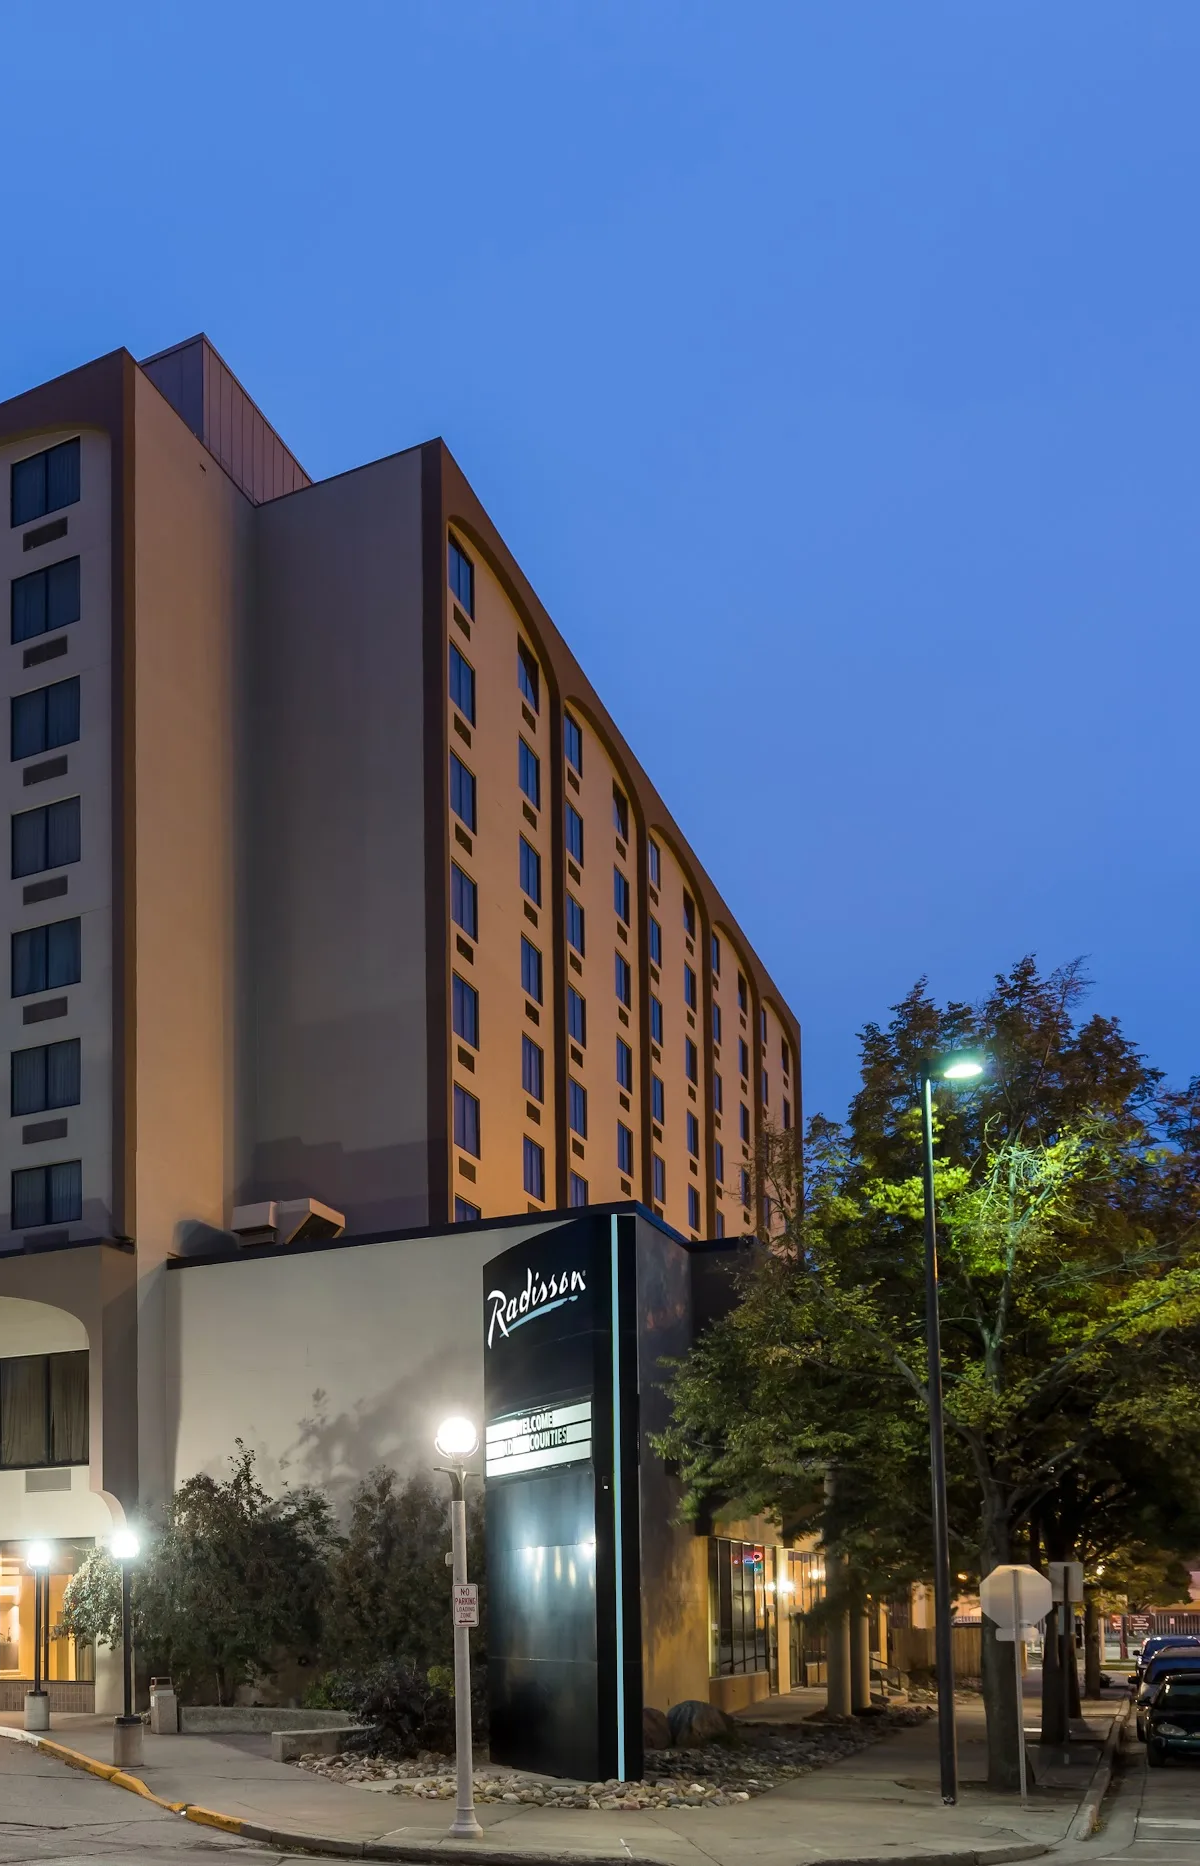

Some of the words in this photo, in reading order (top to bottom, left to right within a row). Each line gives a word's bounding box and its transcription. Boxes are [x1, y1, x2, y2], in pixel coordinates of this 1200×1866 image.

[487, 1267, 586, 1349] Radisson
[516, 1411, 553, 1436] WELCOME
[529, 1426, 567, 1451] COUNTIES
[460, 1588, 470, 1596] NO
